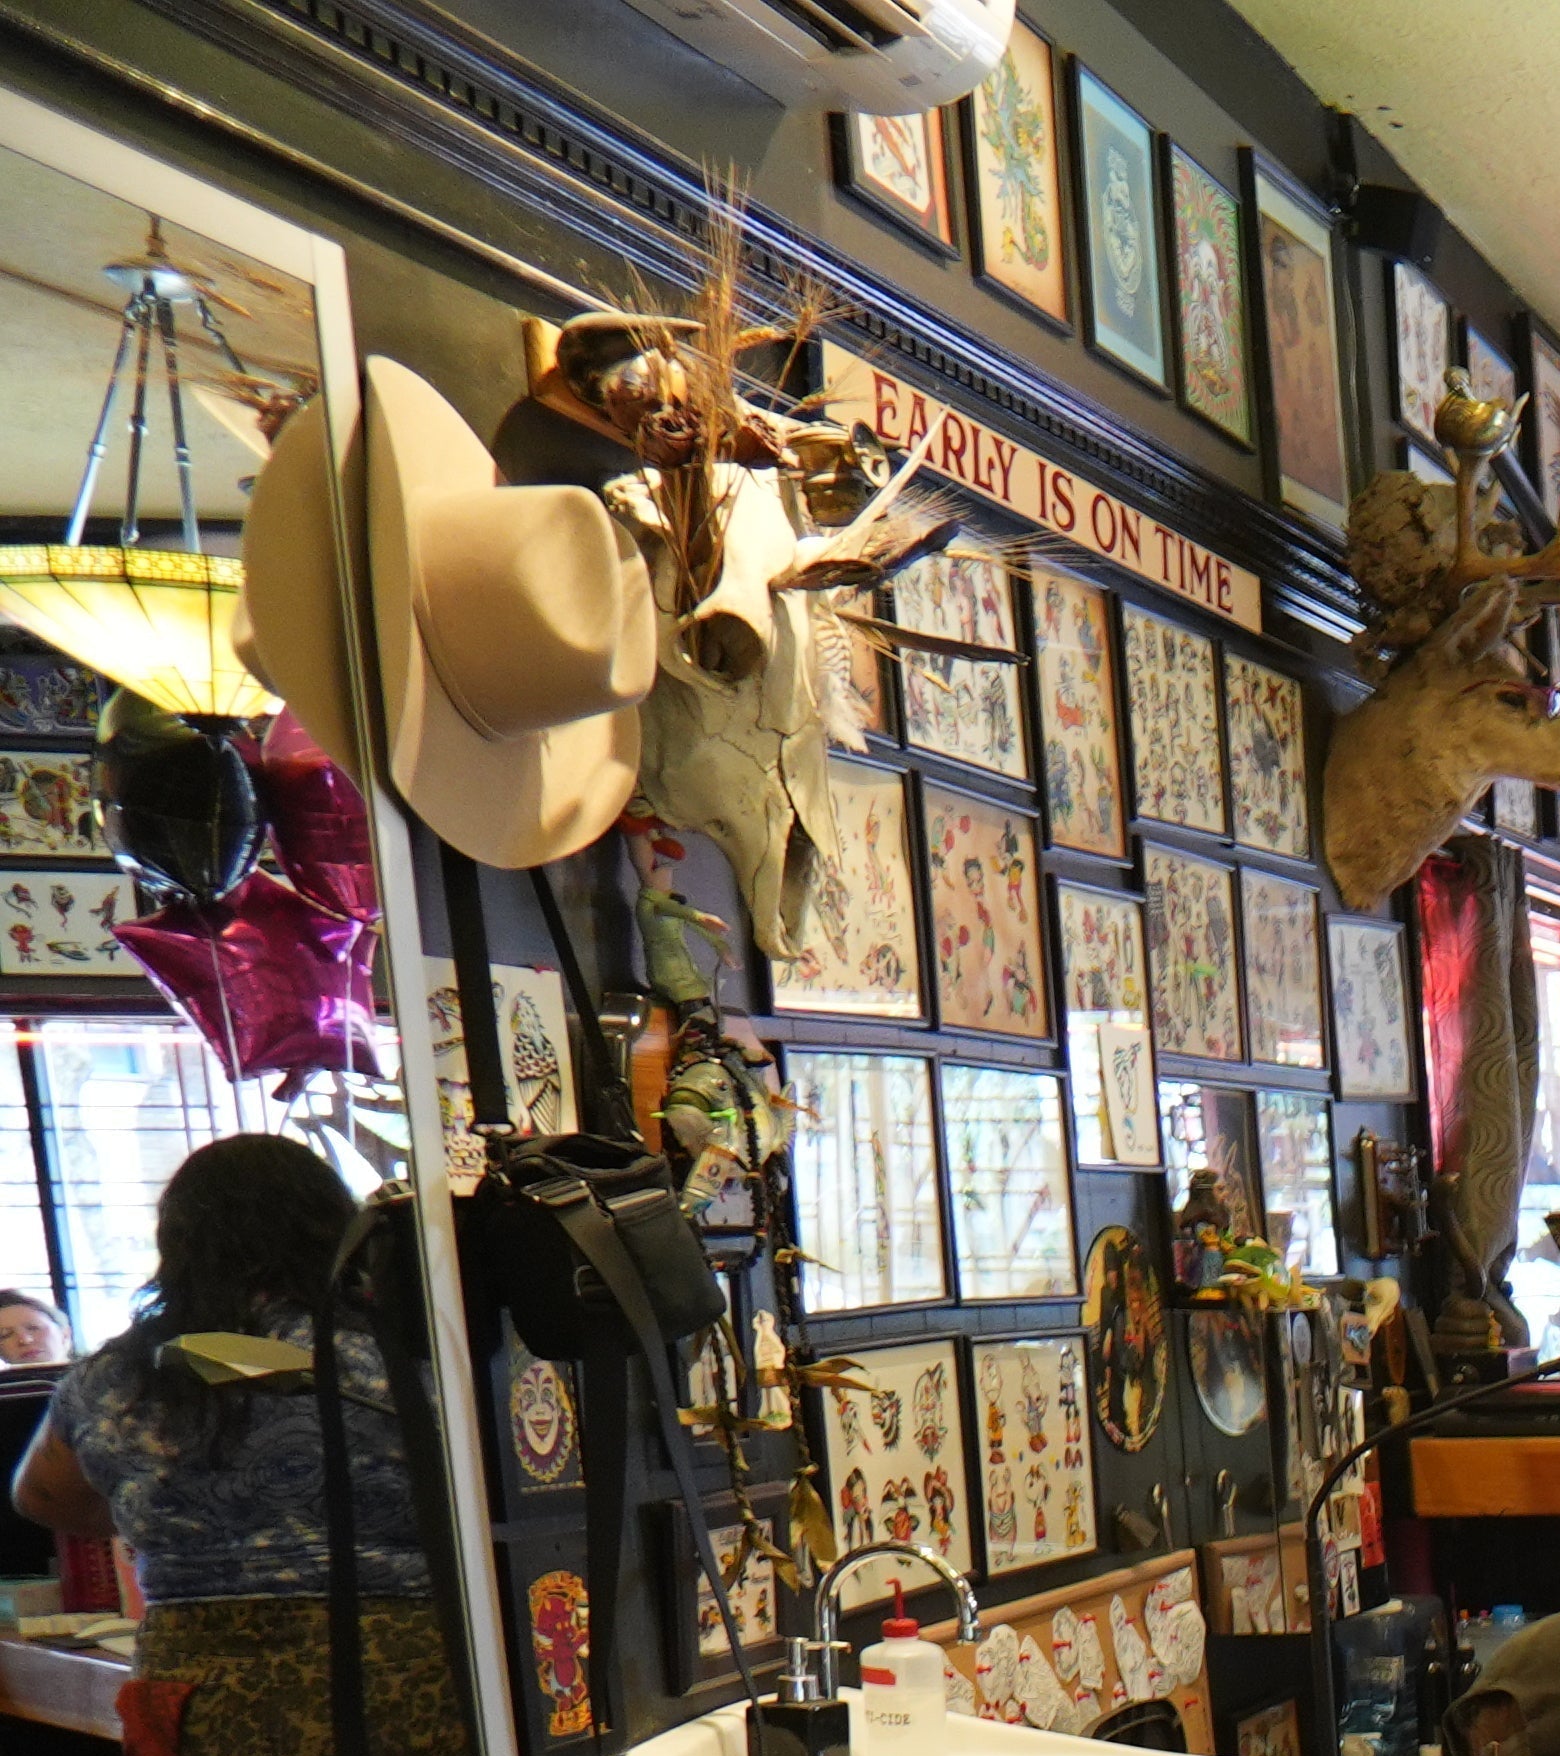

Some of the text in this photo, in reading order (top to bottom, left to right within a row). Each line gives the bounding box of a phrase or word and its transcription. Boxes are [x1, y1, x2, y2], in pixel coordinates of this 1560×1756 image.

[872, 370, 1234, 614] EARLY IS ON TIME
